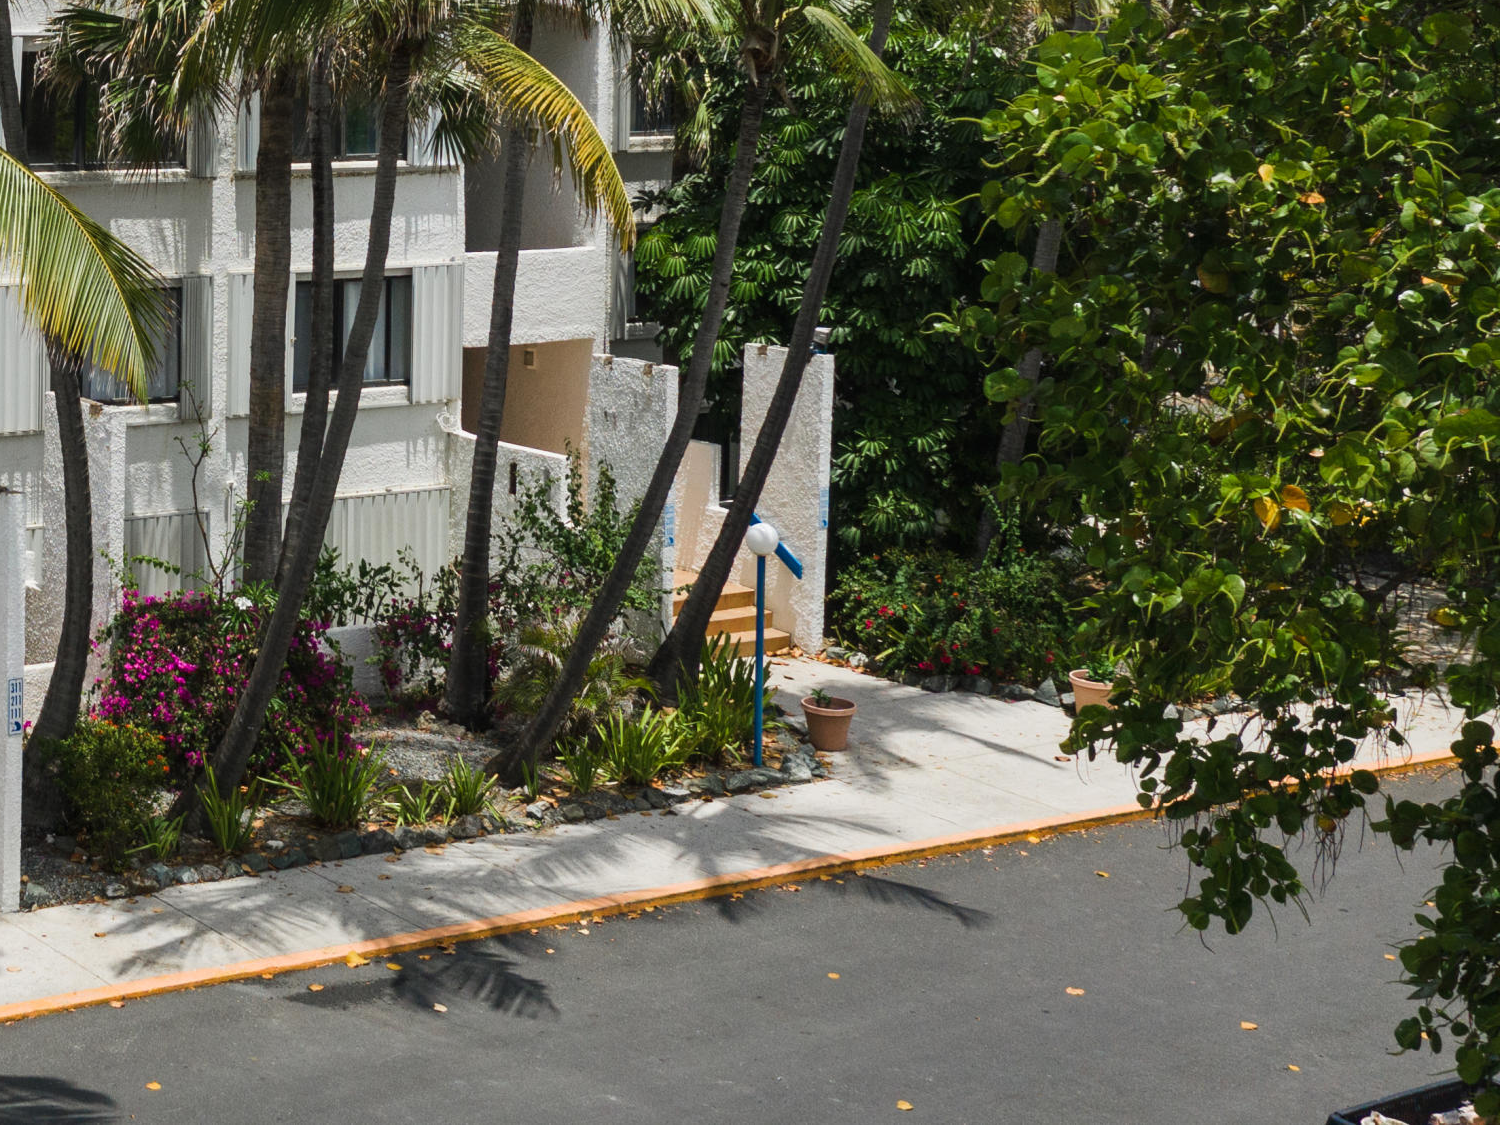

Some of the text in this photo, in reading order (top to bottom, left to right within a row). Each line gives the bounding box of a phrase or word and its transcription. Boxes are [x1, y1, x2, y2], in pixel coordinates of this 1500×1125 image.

[10, 682, 22, 694] 311
[10, 694, 22, 707] 211
[10, 708, 21, 719] 111
